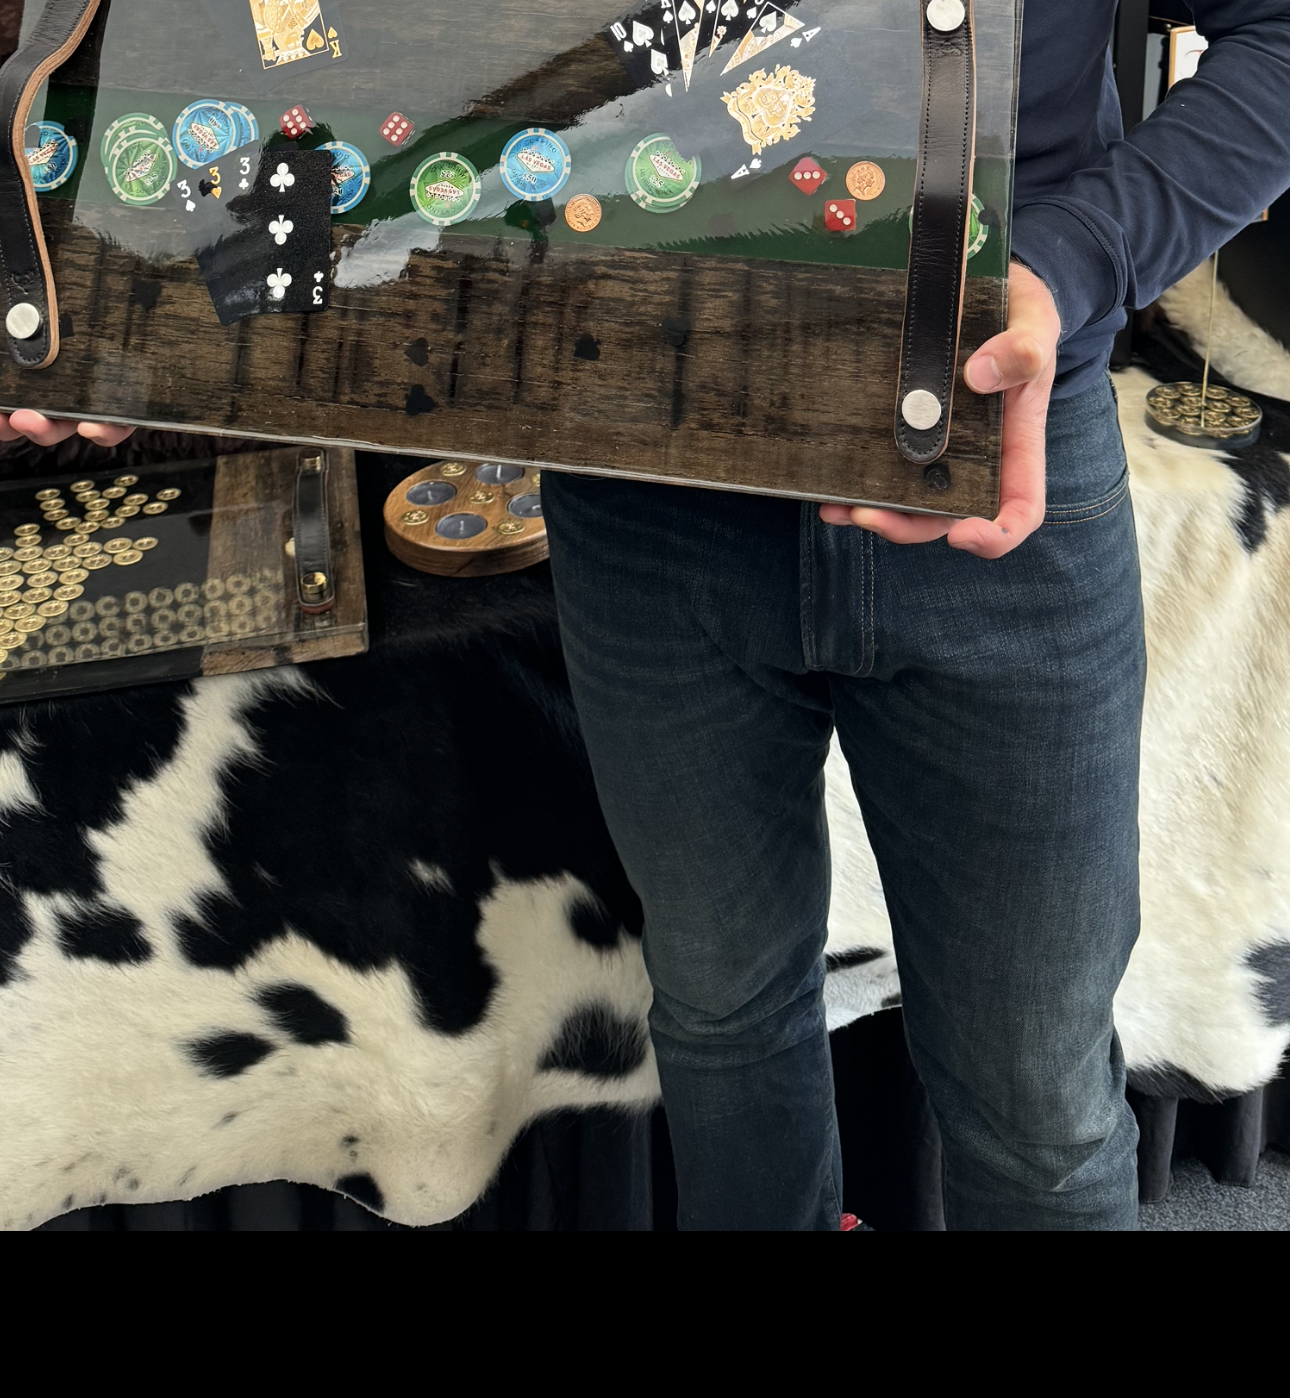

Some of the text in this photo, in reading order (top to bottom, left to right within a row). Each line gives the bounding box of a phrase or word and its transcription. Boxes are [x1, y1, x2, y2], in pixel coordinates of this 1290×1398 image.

[609, 21, 627, 42] 10
[802, 26, 821, 43] A
[329, 40, 342, 59] K
[240, 157, 250, 175] 3
[521, 155, 532, 164] LAS
[532, 158, 552, 171] VEGAS
[653, 157, 664, 167] LAS
[663, 164, 680, 180] VEGAS
[208, 166, 221, 185] 3
[177, 179, 191, 198] 3
[312, 286, 324, 305] 3
